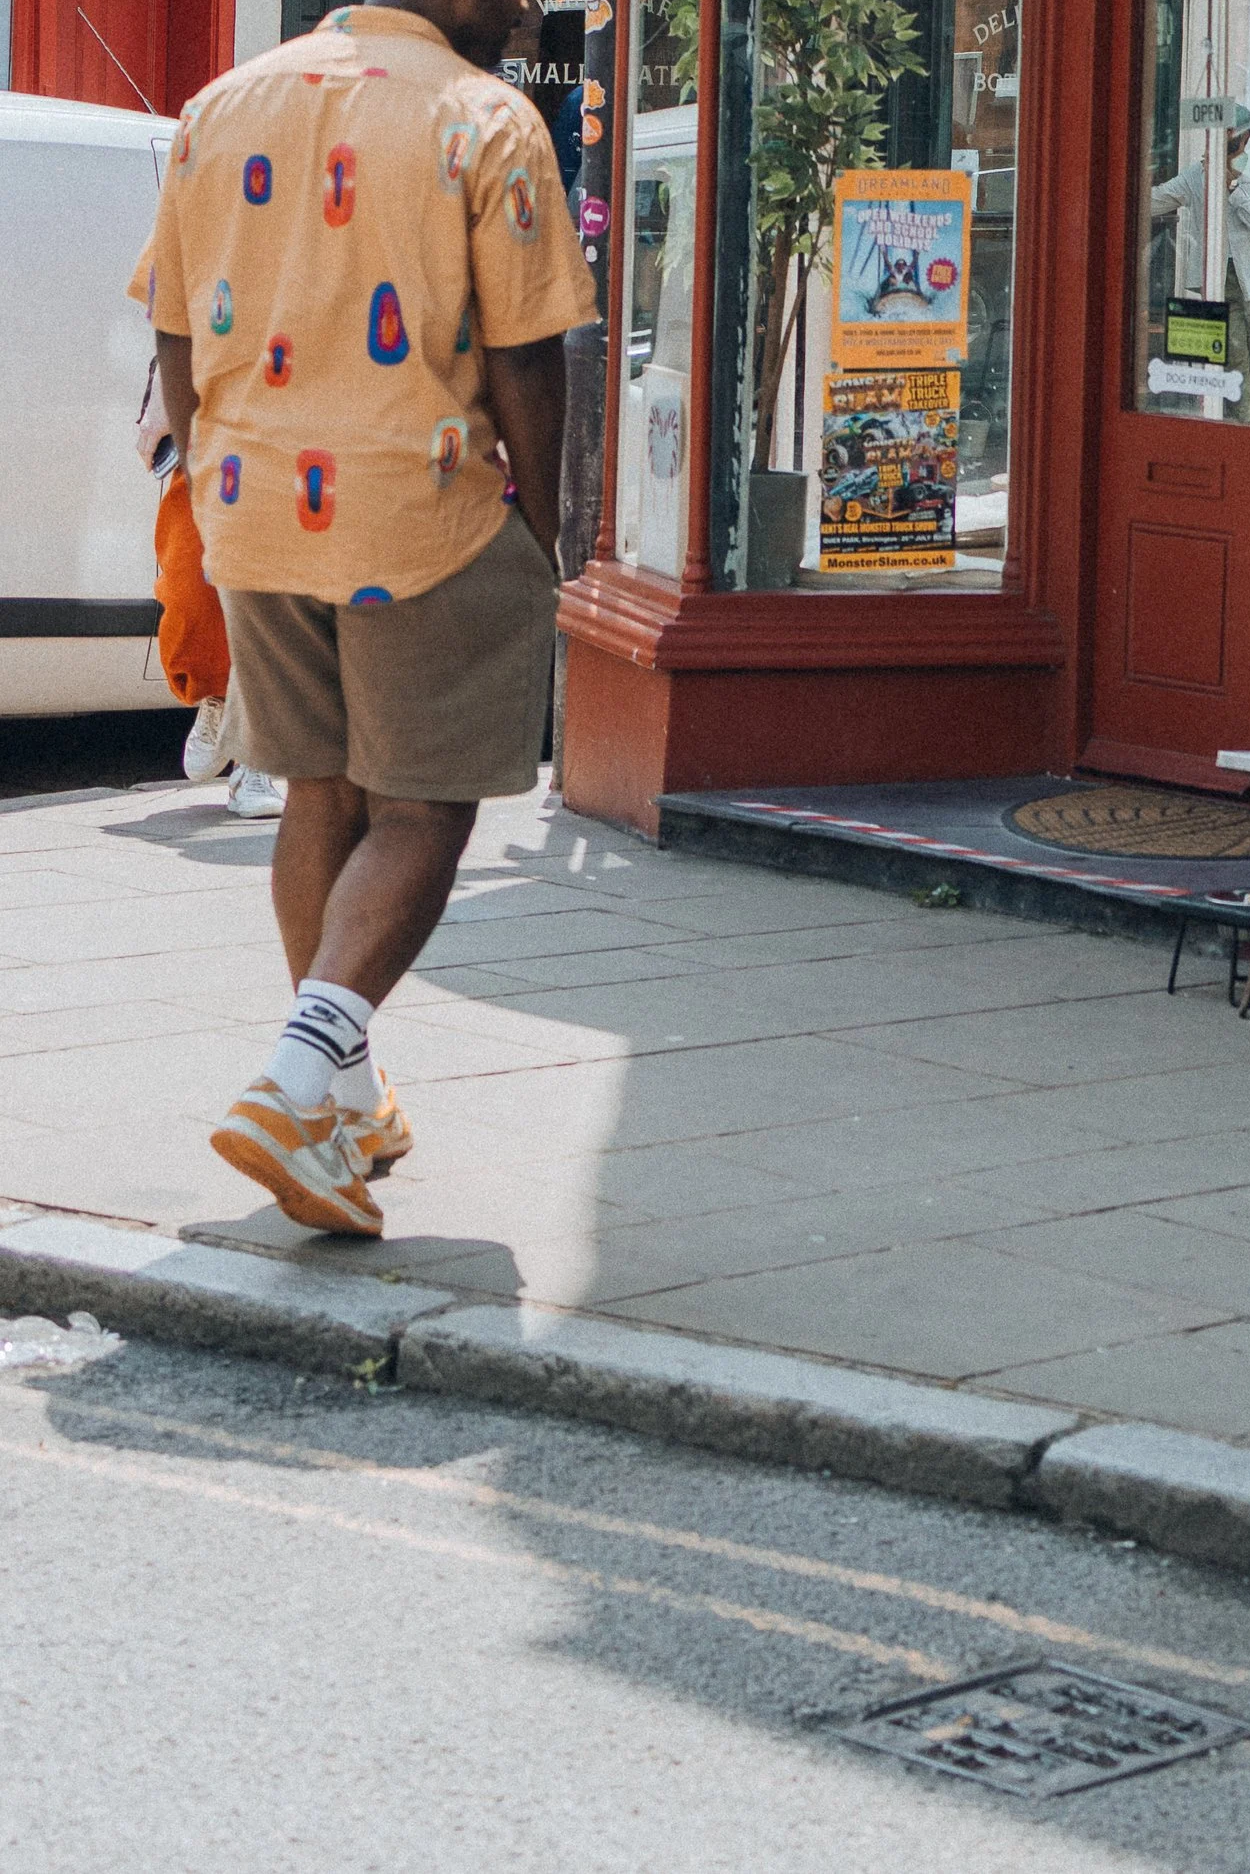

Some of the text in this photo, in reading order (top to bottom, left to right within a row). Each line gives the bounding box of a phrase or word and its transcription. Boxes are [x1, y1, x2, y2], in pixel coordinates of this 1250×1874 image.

[1192, 103, 1224, 124] OPEN
[857, 176, 951, 195] DREAMLAND
[857, 207, 953, 227] OPEN WEEKENDS
[894, 223, 940, 239] SCHOOL
[908, 373, 946, 387] TRIPLE
[1165, 372, 1187, 384] DOG
[909, 386, 946, 400] TRUCK
[827, 555, 947, 568] MonsterSlam.co.uk
